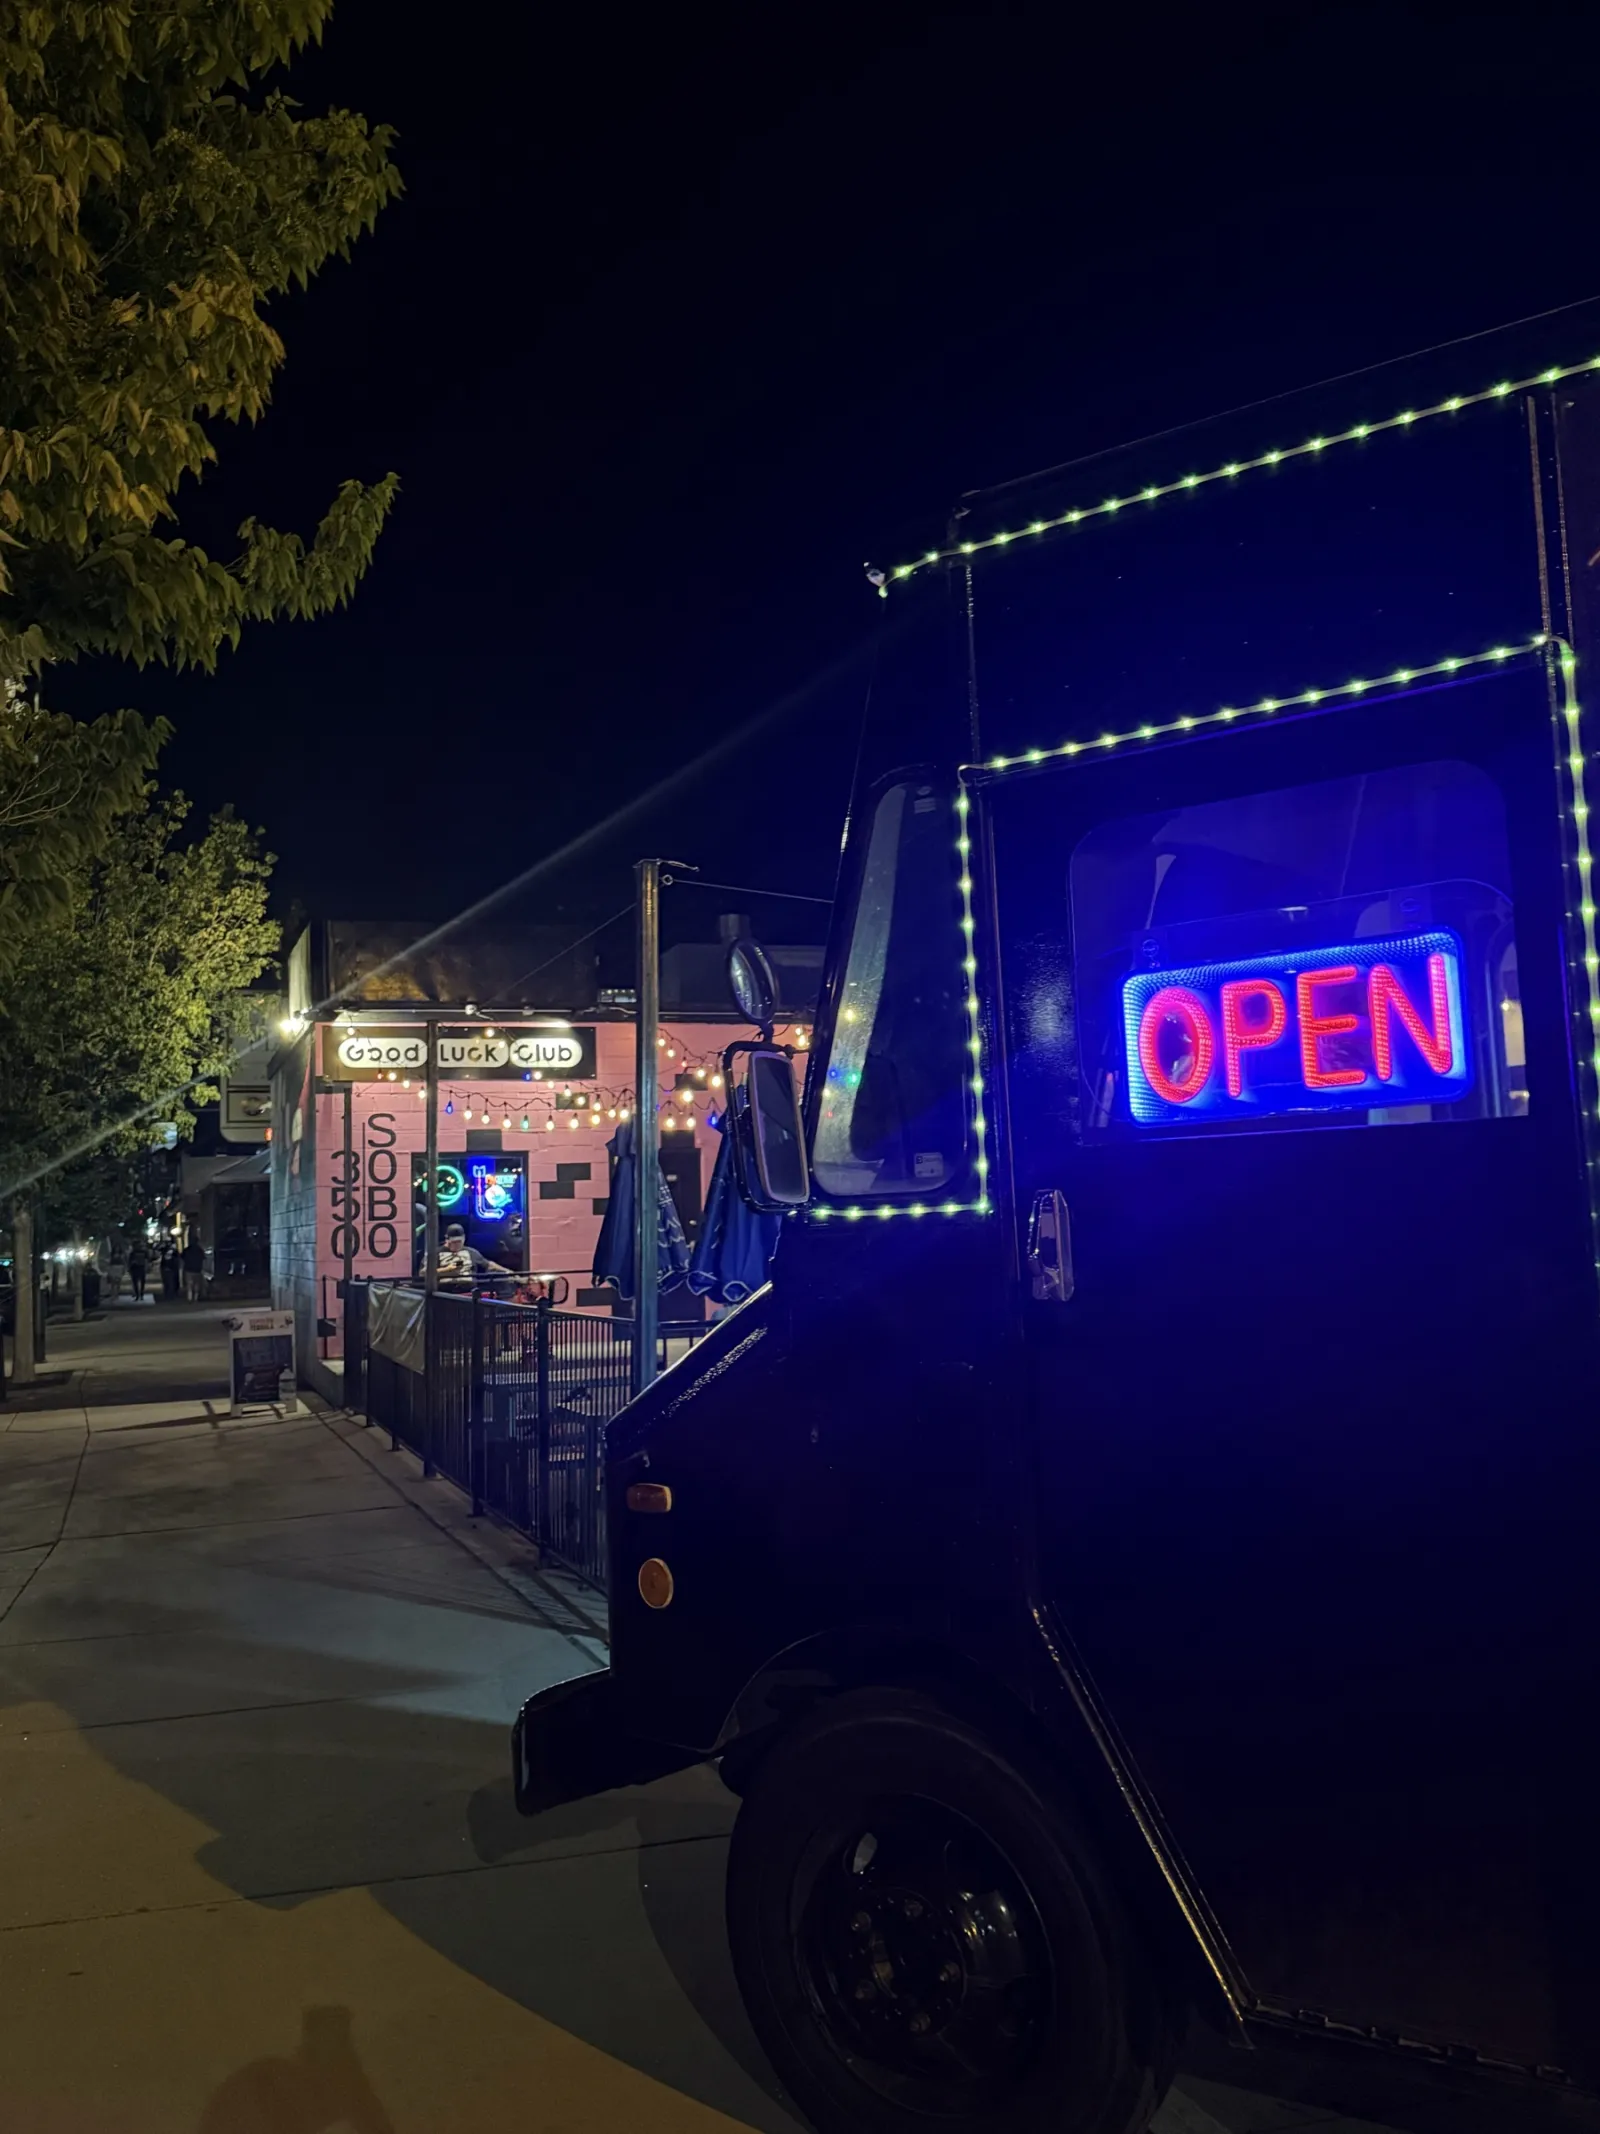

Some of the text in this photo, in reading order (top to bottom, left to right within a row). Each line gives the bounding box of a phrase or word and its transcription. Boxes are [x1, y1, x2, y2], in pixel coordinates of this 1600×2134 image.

[346, 1043, 420, 1061] Good
[515, 1043, 573, 1062] Club
[1140, 953, 1453, 1104] OPEN
[331, 1150, 361, 1259] 350
[367, 1113, 398, 1258] SOBO
